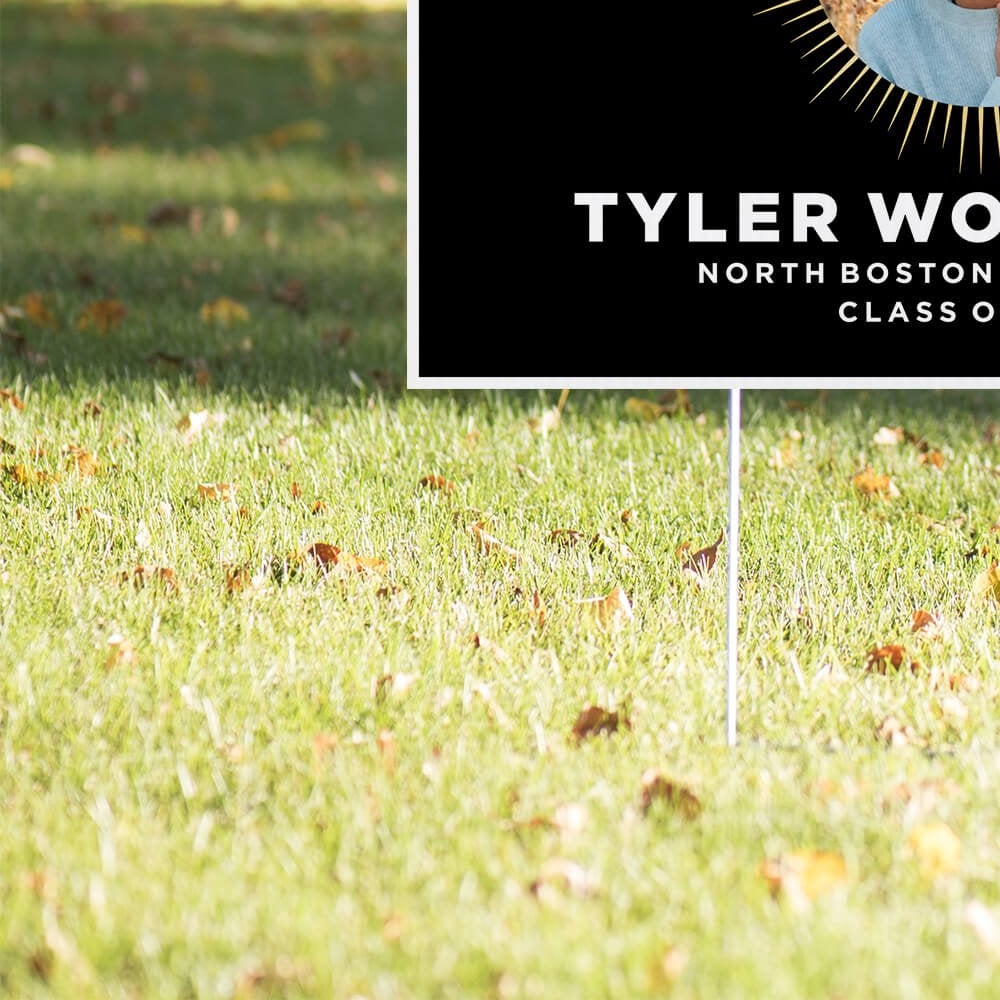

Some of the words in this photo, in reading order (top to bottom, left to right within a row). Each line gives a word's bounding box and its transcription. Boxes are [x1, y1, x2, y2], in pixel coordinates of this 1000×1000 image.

[574, 192, 838, 243] TYLER
[698, 262, 825, 284] NORTH
[841, 262, 992, 284] BOSTON
[838, 301, 957, 323] CLASS
